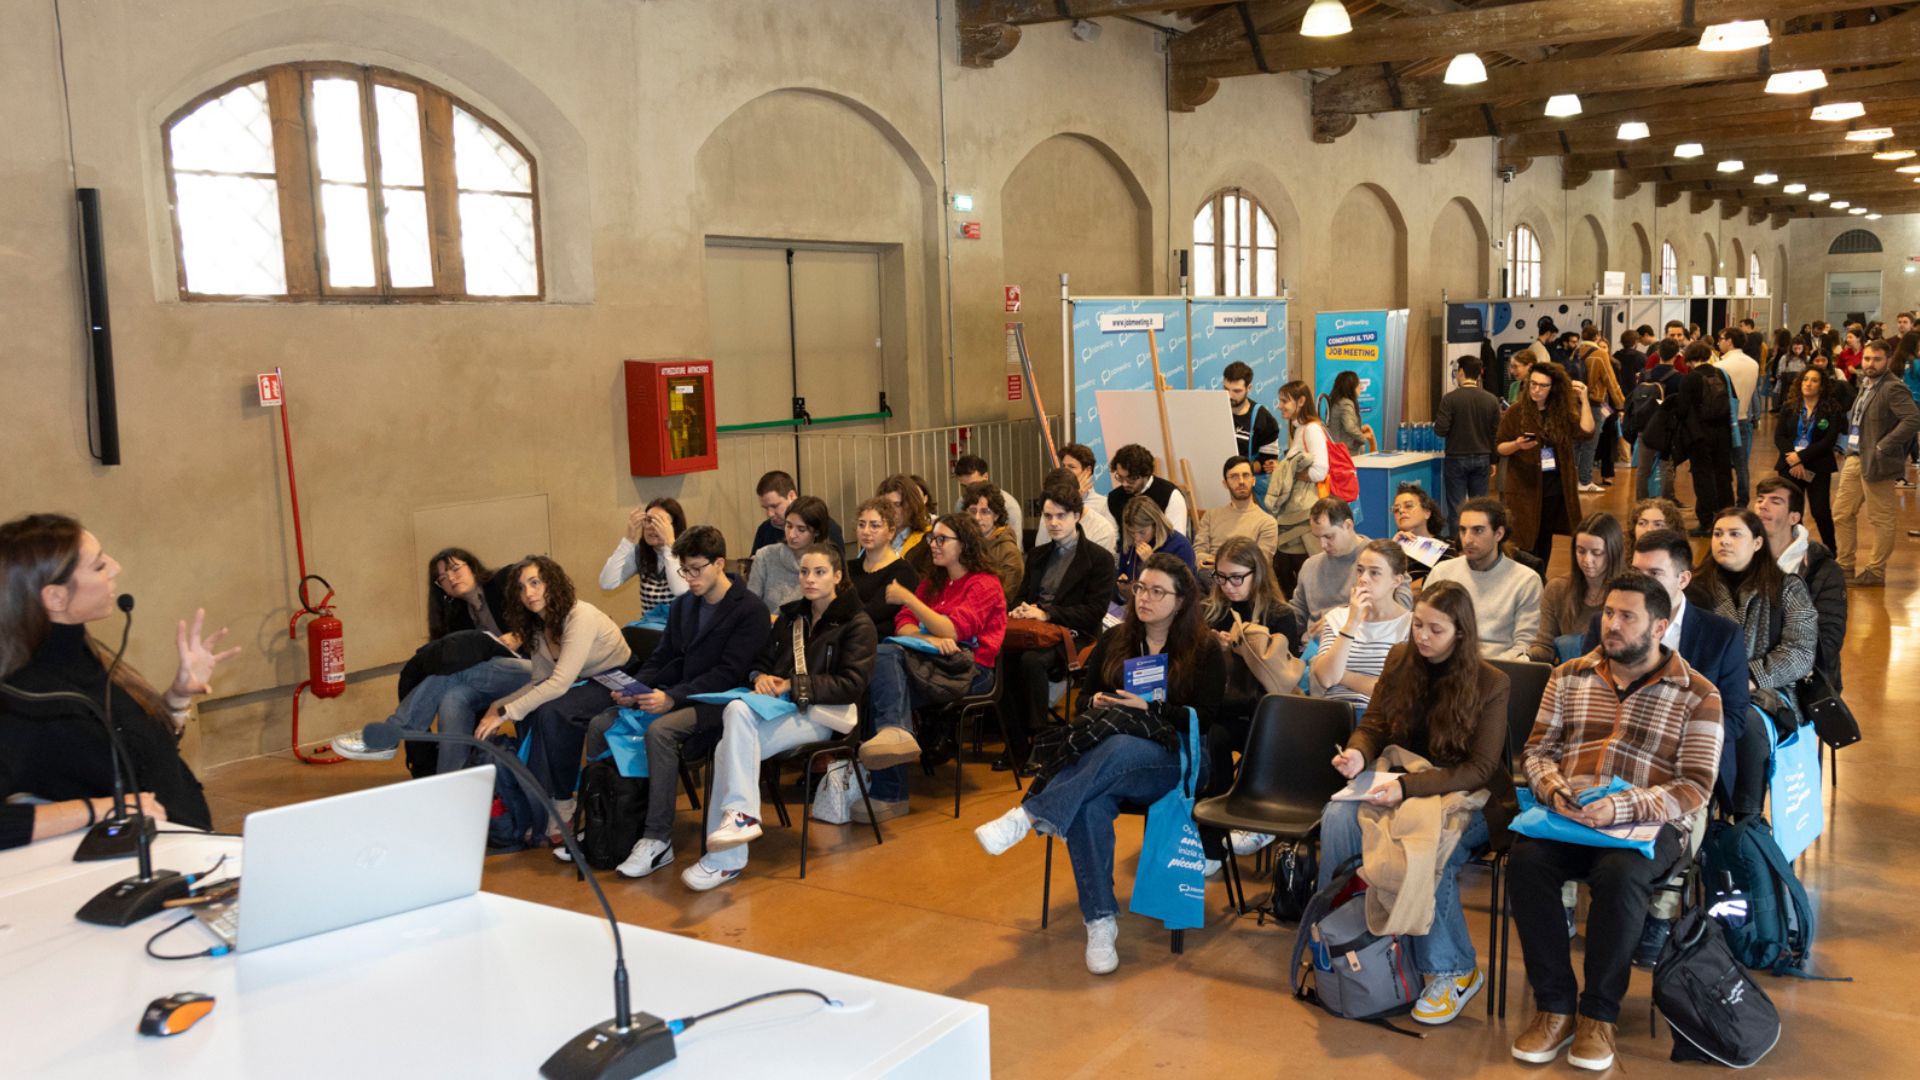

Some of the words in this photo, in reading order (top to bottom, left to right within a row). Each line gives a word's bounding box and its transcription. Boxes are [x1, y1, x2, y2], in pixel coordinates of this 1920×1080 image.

[1112, 318, 1153, 328] www.jobmeeting.it
[1328, 348, 1342, 356] JOB
[1343, 348, 1376, 357] MEETING
[1167, 857, 1204, 871] piccolo
